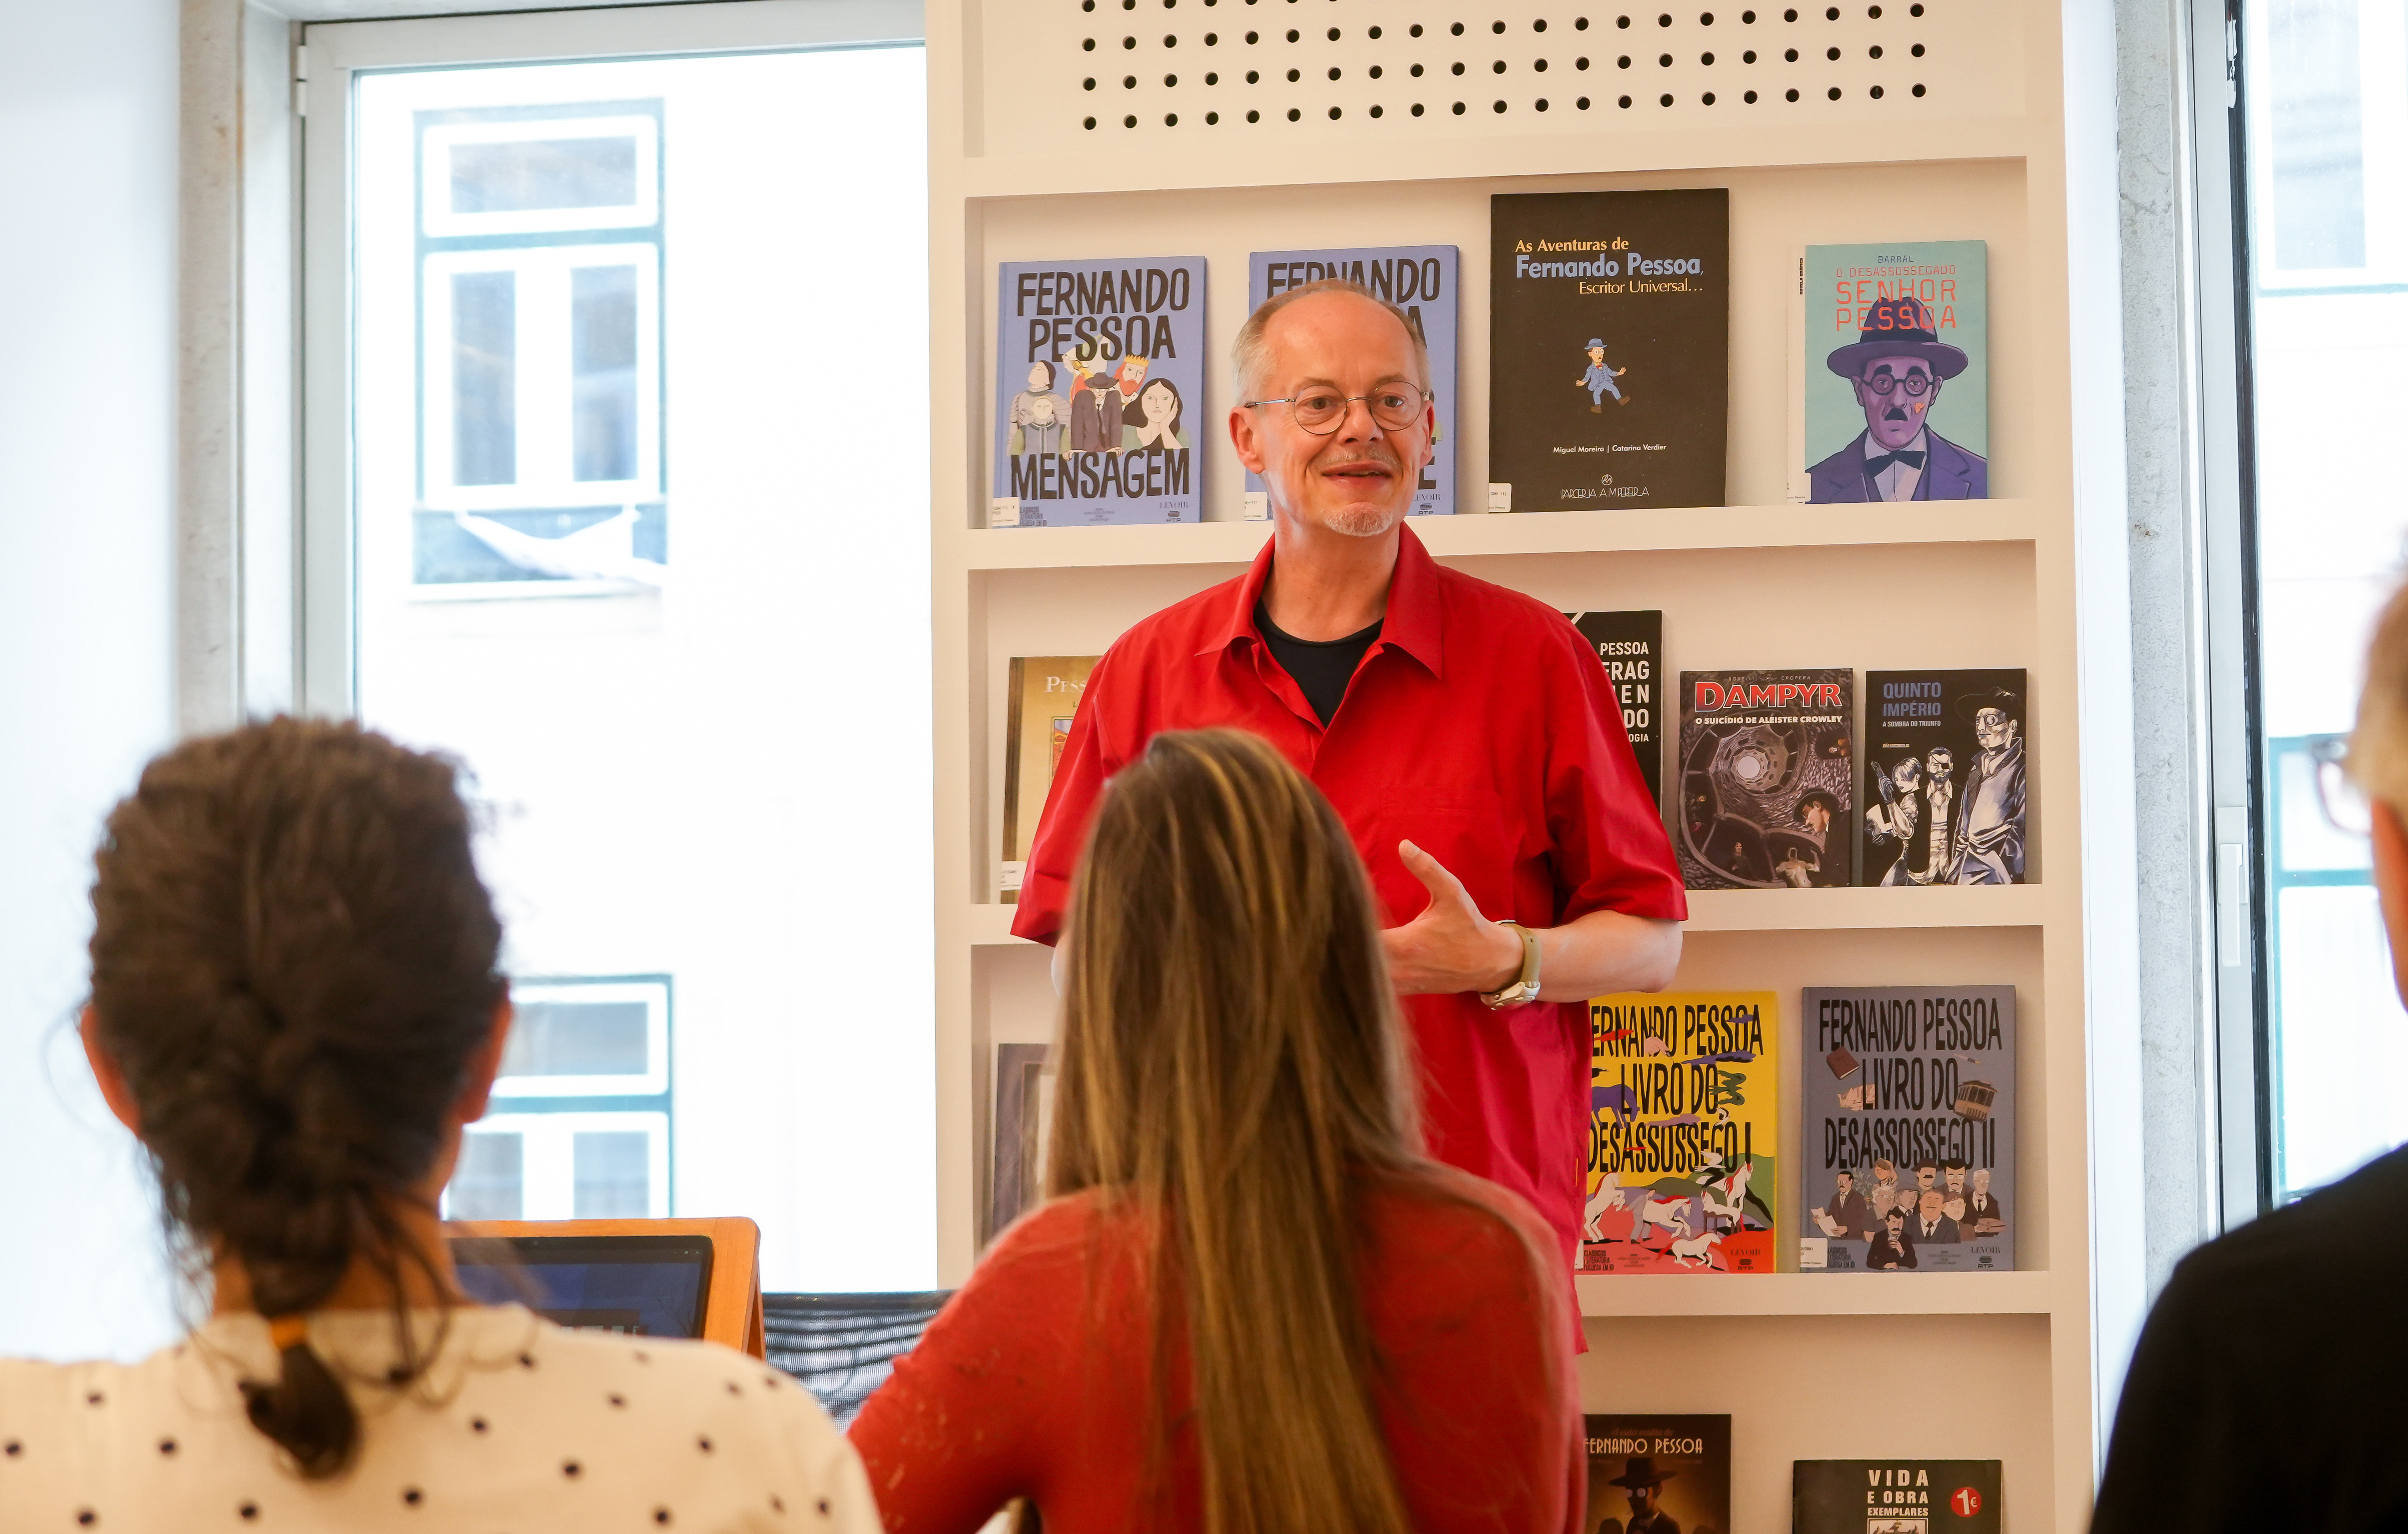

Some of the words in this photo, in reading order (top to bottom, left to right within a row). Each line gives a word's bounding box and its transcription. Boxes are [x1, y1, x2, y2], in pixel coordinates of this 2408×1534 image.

[1515, 239, 1533, 252] As
[1537, 239, 1607, 252] Aventuras
[1612, 236, 1629, 250] de
[1517, 253, 1619, 278] Fernando
[1628, 252, 1704, 276] Pessoa,
[1878, 255, 1914, 263] BARRAL
[1836, 268, 1843, 277] O
[1850, 265, 1955, 277] DESASSOSSEGADO
[1018, 268, 1190, 316] FERNANDO
[1579, 281, 1625, 294] Escritor
[1836, 279, 1956, 304] SENHOR
[1836, 305, 1956, 331] PESSOA
[1029, 315, 1176, 363] PESSOA
[1553, 446, 1576, 454] Miguel
[1011, 448, 1190, 500] MENSAGEM
[1600, 642, 1649, 655] PESSOA
[1695, 681, 1843, 712] DAMPYR
[1884, 682, 1941, 699] QUINTO
[1883, 701, 1941, 716] IMPÉRIO
[1704, 716, 1743, 724] SUICÍDIO
[1590, 1005, 1677, 1057] ERNANDO
[1685, 1004, 1764, 1056] PESSOA
[1820, 999, 1916, 1052] FERNANDO
[1924, 998, 2002, 1051] PESSOA
[1621, 1062, 1684, 1115] LIVRO
[1691, 1063, 1719, 1115] DO
[1863, 1057, 1924, 1111] LIVRO
[1931, 1057, 1958, 1111] DO
[1825, 1117, 1975, 1169] DESASSOSSEGO
[1982, 1117, 1995, 1168] II
[1583, 1438, 1647, 1453] FERNANDO
[1655, 1438, 1703, 1453] PESSOA
[1868, 1469, 1929, 1486] VIDA
[1867, 1491, 1874, 1504] E
[1883, 1491, 1929, 1504] OBRA
[1868, 1507, 1929, 1516] EXEMPLARES
